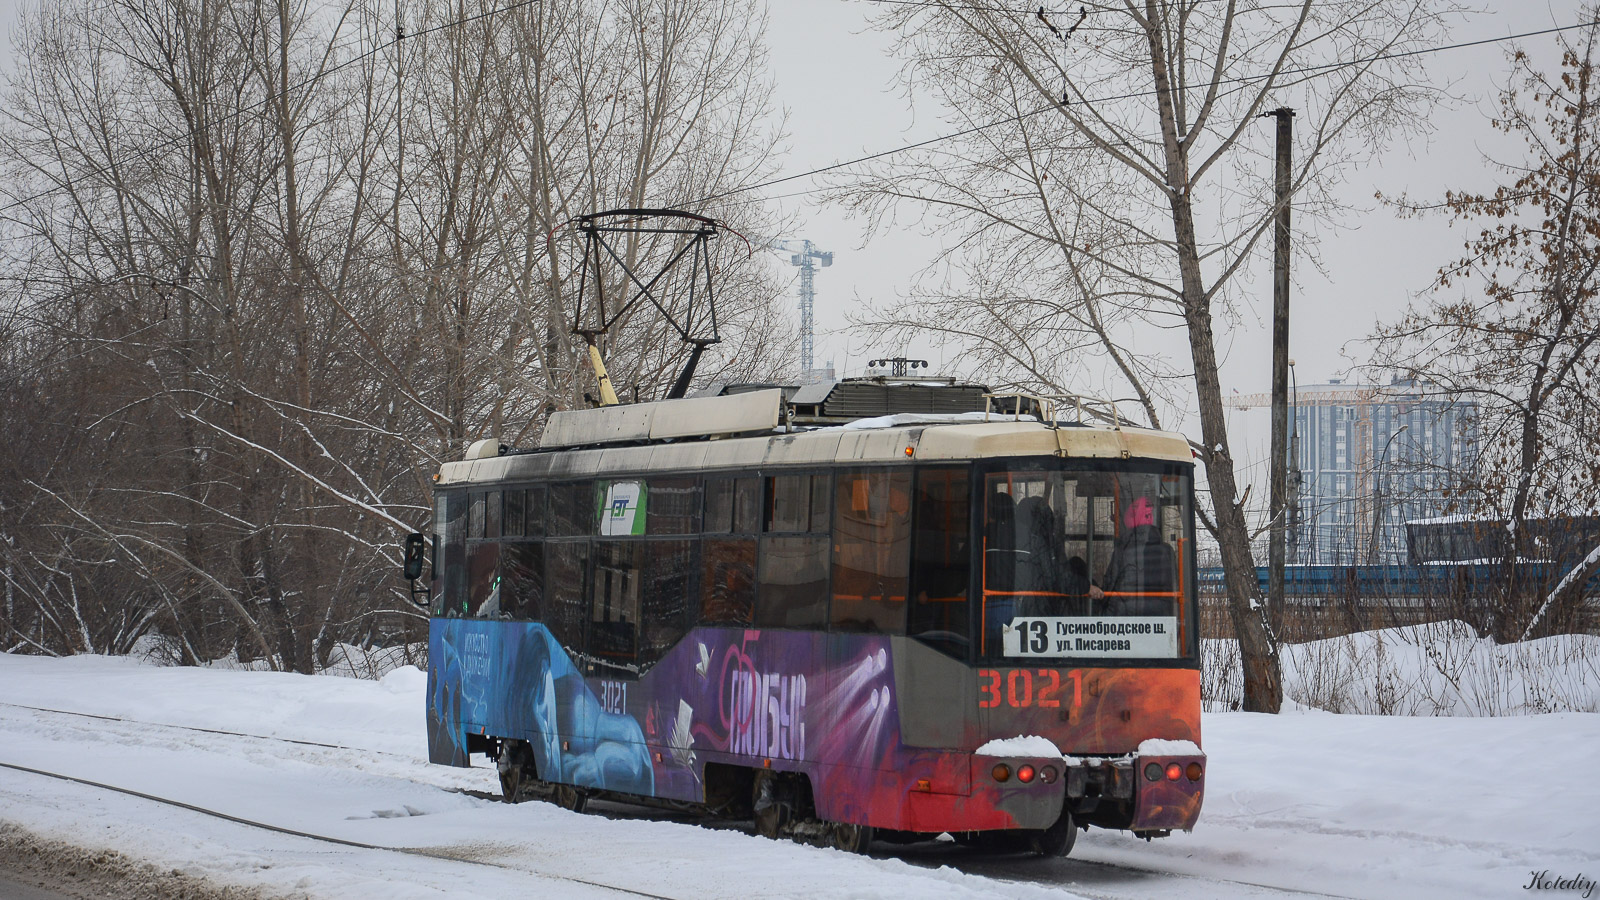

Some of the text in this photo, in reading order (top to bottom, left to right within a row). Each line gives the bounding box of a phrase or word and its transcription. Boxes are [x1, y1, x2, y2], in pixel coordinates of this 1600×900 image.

[1015, 621, 1049, 654] 13
[1056, 622, 1167, 635] Гусинобродское ш.
[1056, 638, 1131, 652] ул. Писарева
[601, 680, 627, 715] 3021
[979, 669, 1082, 708] 3021
